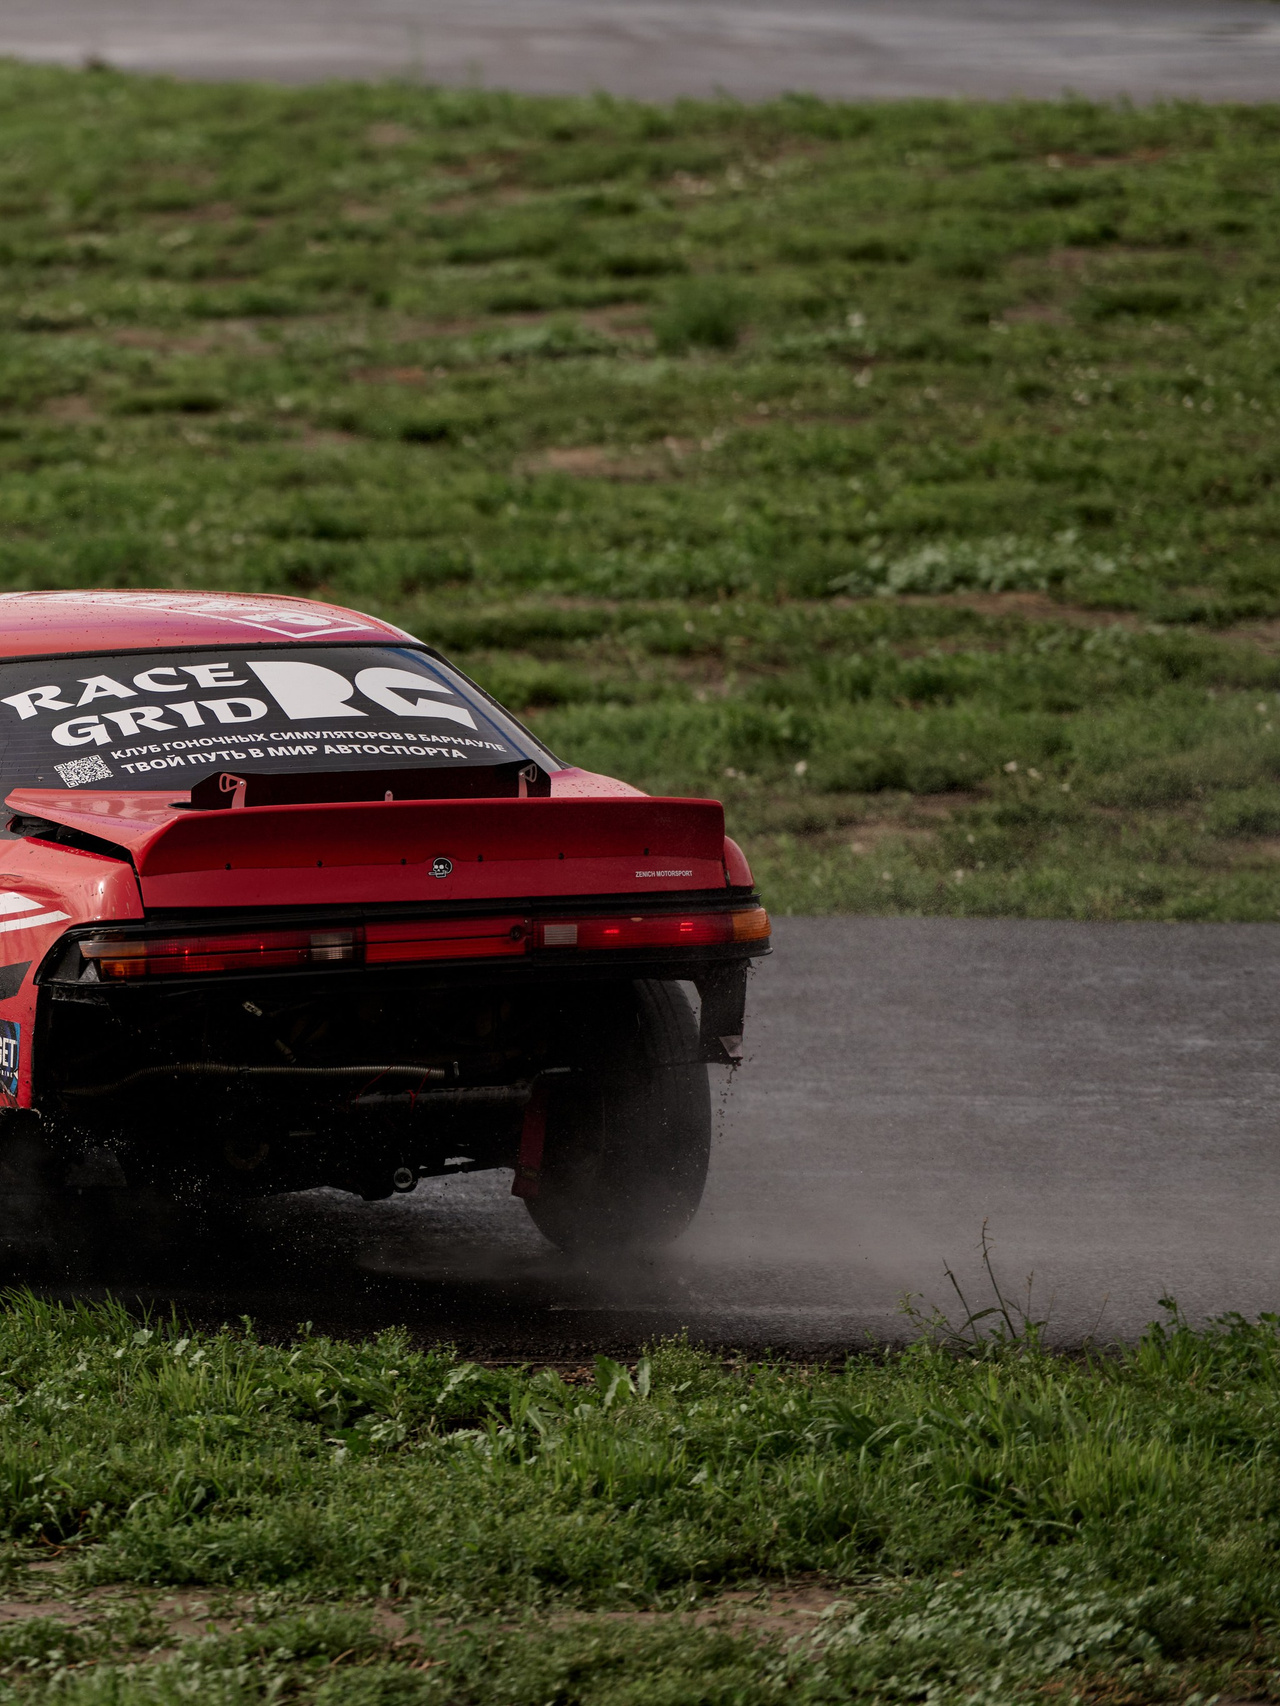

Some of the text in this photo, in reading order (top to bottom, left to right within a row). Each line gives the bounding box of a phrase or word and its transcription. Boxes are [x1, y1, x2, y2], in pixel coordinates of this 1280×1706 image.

[0, 662, 248, 721] RACE
[51, 697, 269, 748] GRID
[111, 731, 508, 760] КЛУБ ГОНОЧНЫХ СИМУЛЯТОРОВ В БАРНАУЛЕ
[121, 742, 468, 775] ТВОЙ ПУТЬ В МИР АВТОСПОРТА
[635, 870, 693, 878] ZENICH MOTORSPORT
